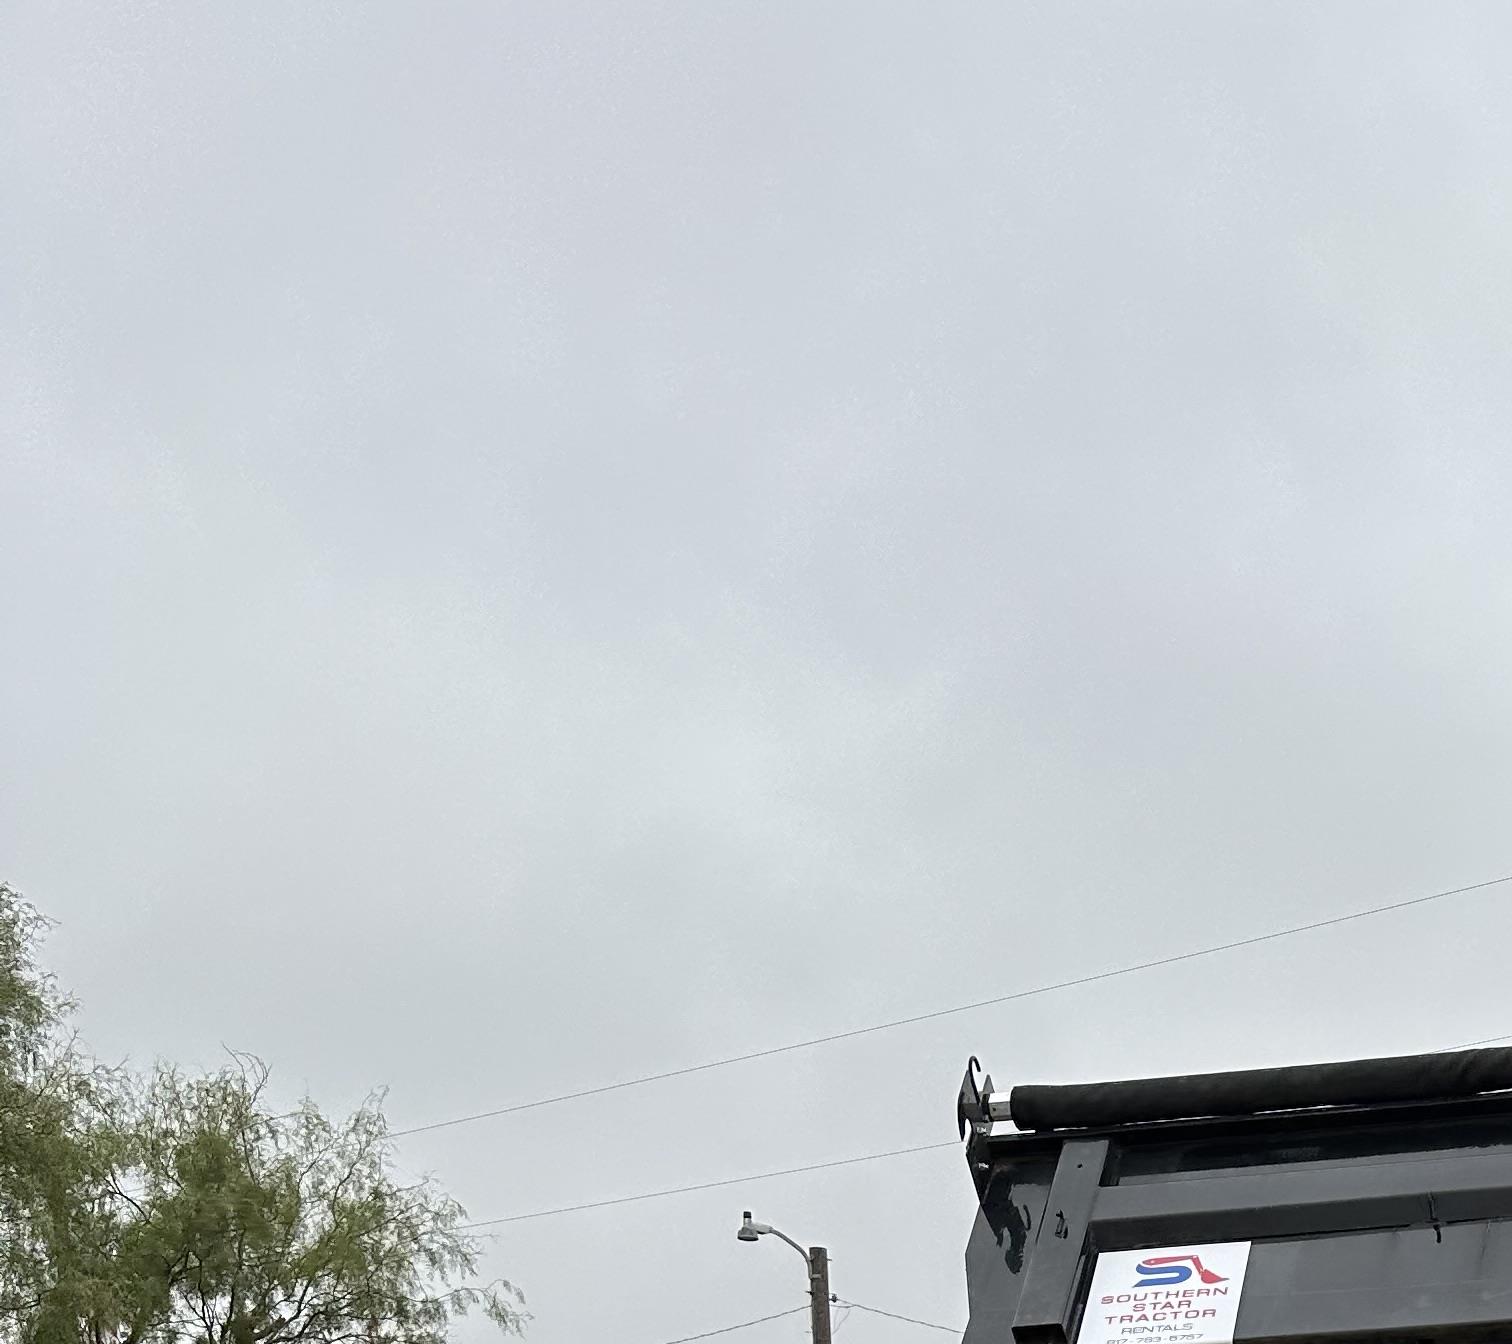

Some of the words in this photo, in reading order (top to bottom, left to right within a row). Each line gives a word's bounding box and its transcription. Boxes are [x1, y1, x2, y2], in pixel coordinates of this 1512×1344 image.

[1101, 1286, 1229, 1305] SOUTHERN
[1133, 1300, 1192, 1312] STAR
[1104, 1309, 1217, 1325] TRACTOR
[1121, 1323, 1193, 1335] RENTALS
